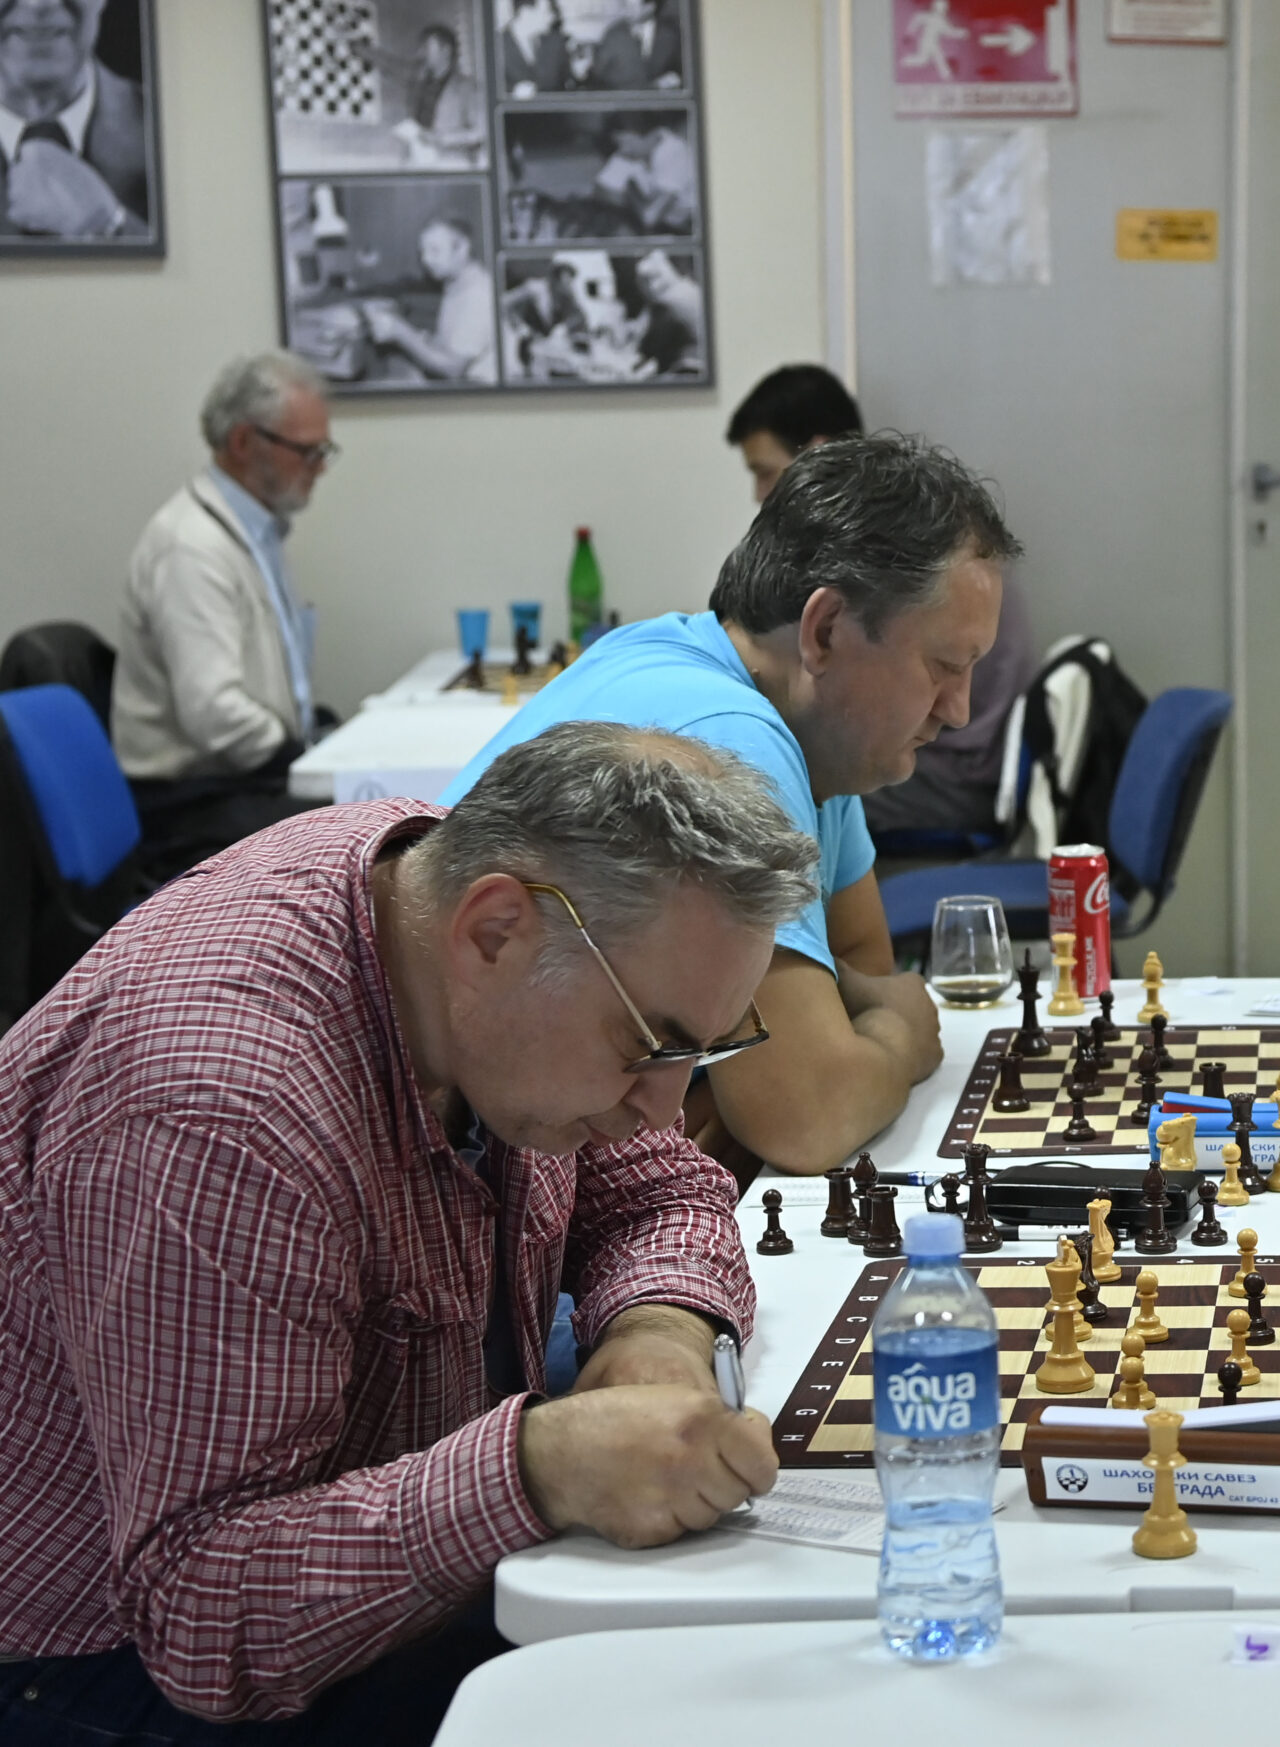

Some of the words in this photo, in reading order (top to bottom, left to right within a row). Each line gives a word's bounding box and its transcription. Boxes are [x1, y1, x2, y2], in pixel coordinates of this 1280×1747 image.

[1205, 1144, 1276, 1152] ШАСКИ
[887, 1371, 977, 1403] aqua
[795, 1408, 818, 1416] G
[892, 1400, 972, 1432] viva
[1103, 1469, 1199, 1481] ШАХОКИ
[1203, 1472, 1257, 1484] САВЕЗ
[1137, 1481, 1226, 1499] БЕРАДА
[1246, 1495, 1268, 1504] БРОЈ
